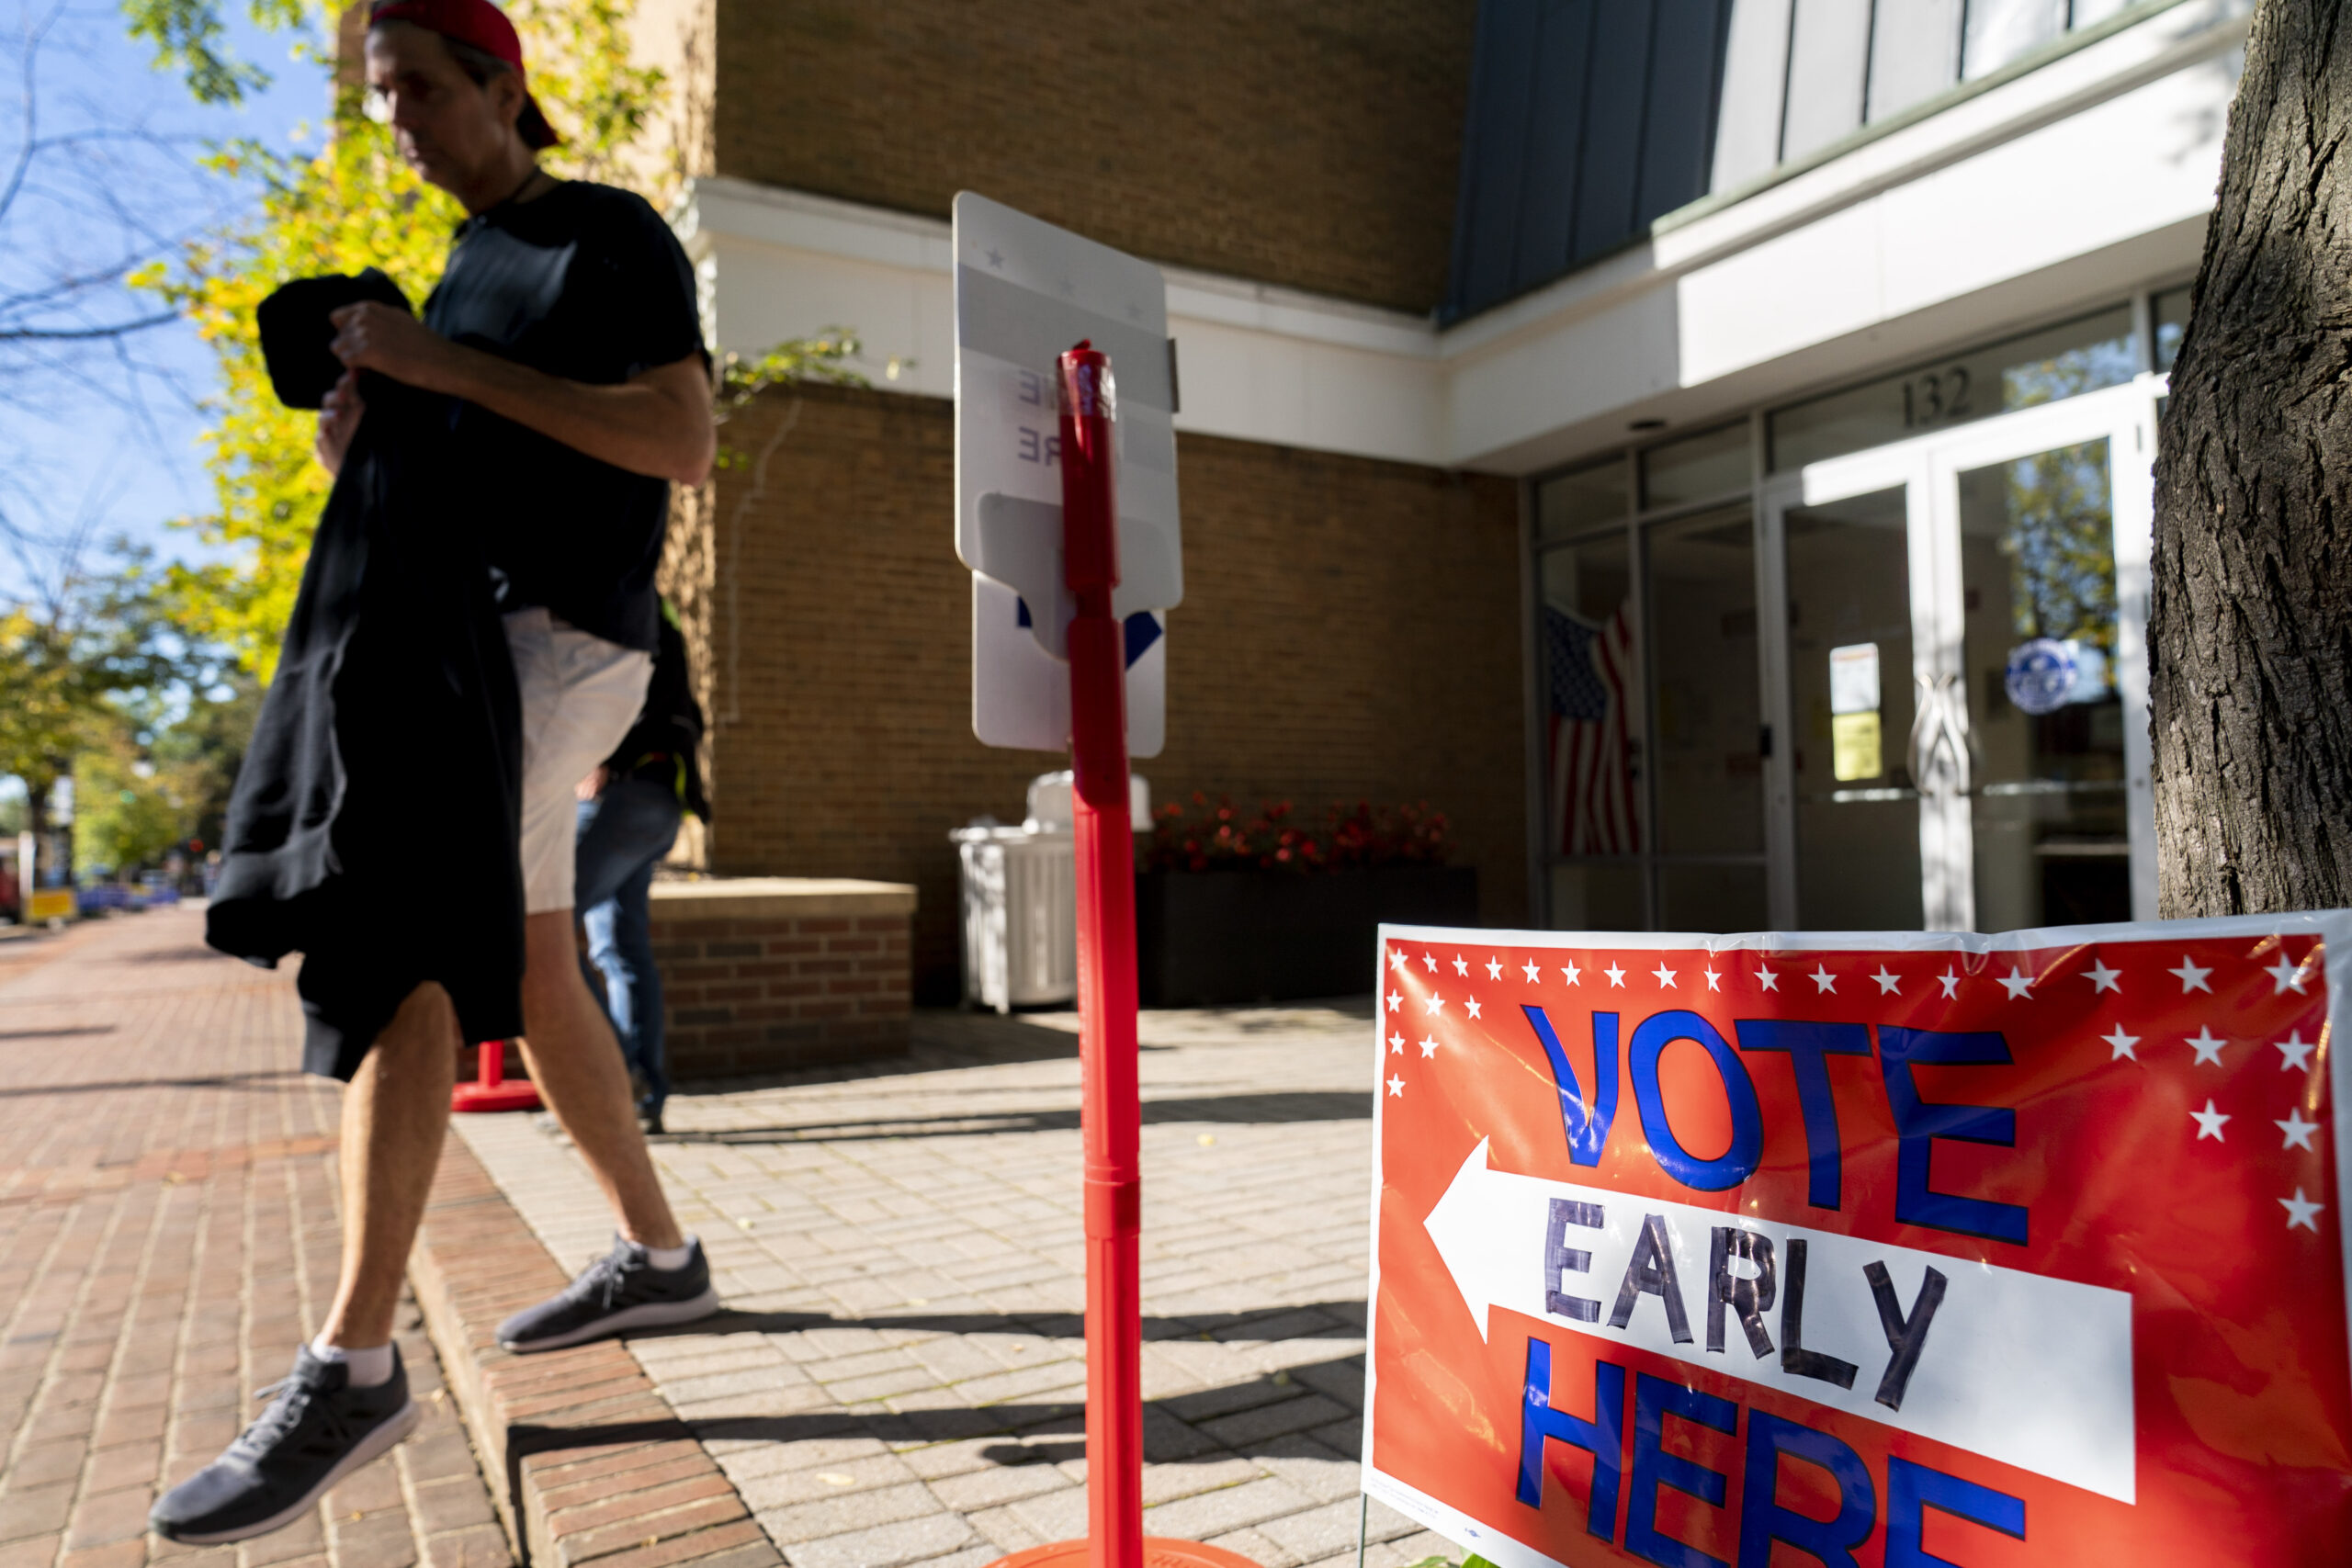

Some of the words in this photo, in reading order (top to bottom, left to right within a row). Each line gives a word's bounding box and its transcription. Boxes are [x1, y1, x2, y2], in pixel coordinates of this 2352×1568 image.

[1902, 366, 1973, 429] 132
[1520, 1004, 2029, 1247] VOTE
[1544, 1198, 1948, 1413] EARLY
